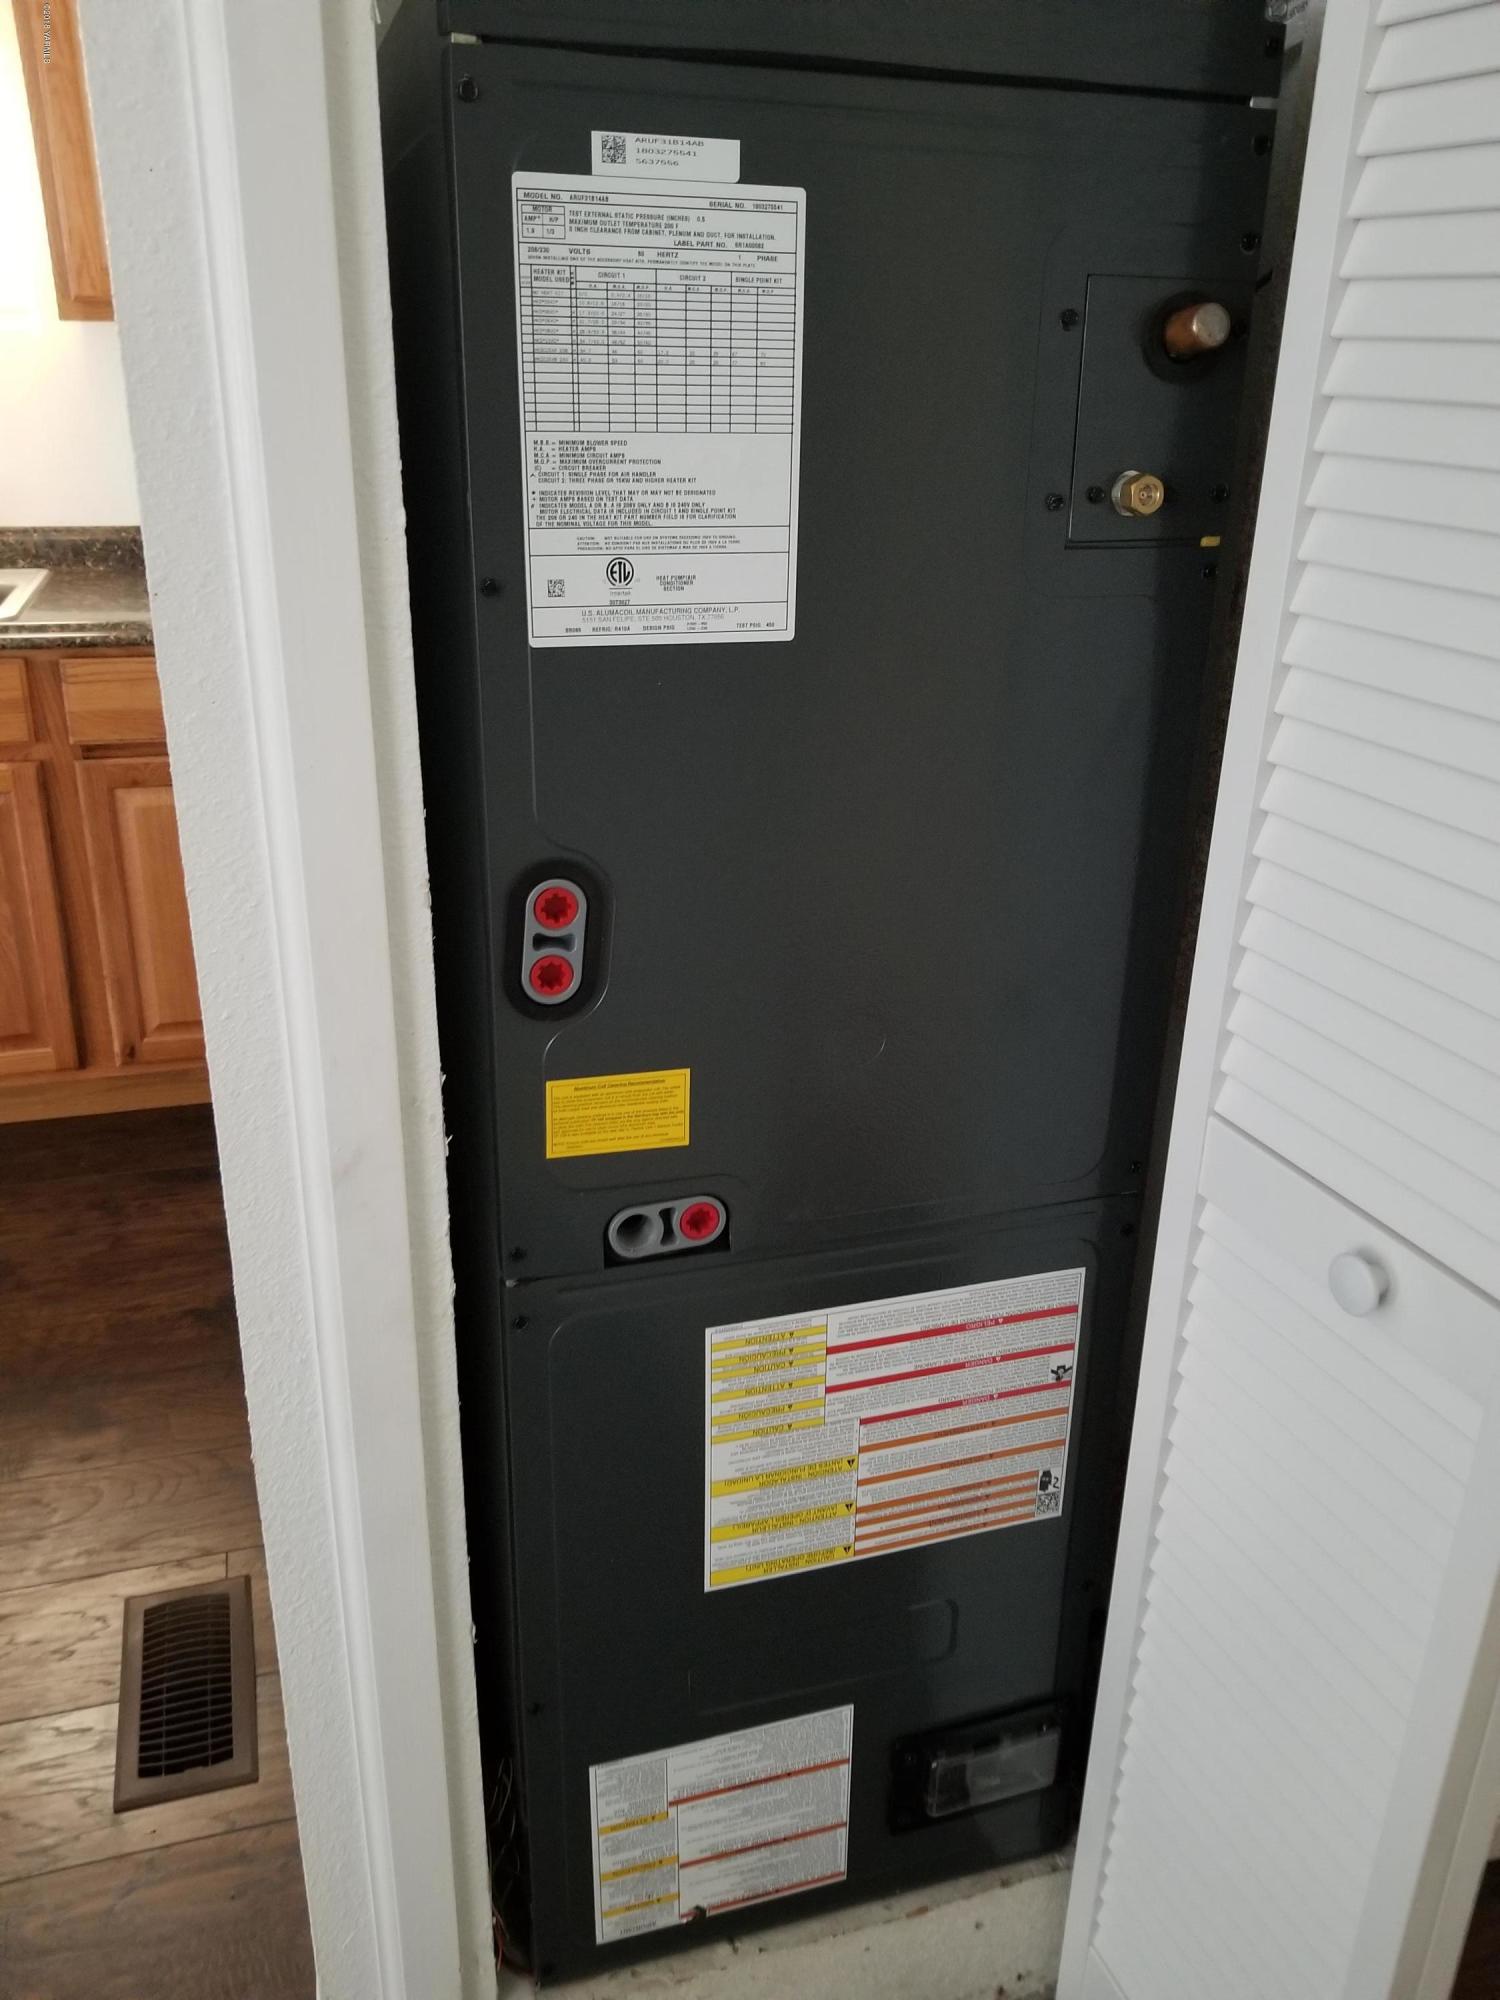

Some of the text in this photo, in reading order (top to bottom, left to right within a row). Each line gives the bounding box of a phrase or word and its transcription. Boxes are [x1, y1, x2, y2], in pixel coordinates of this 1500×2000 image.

[524, 192, 548, 200] MODEL
[709, 201, 732, 209] SERIAL
[584, 210, 613, 218] EXTERNAL
[623, 221, 662, 229] TEMPERATURE
